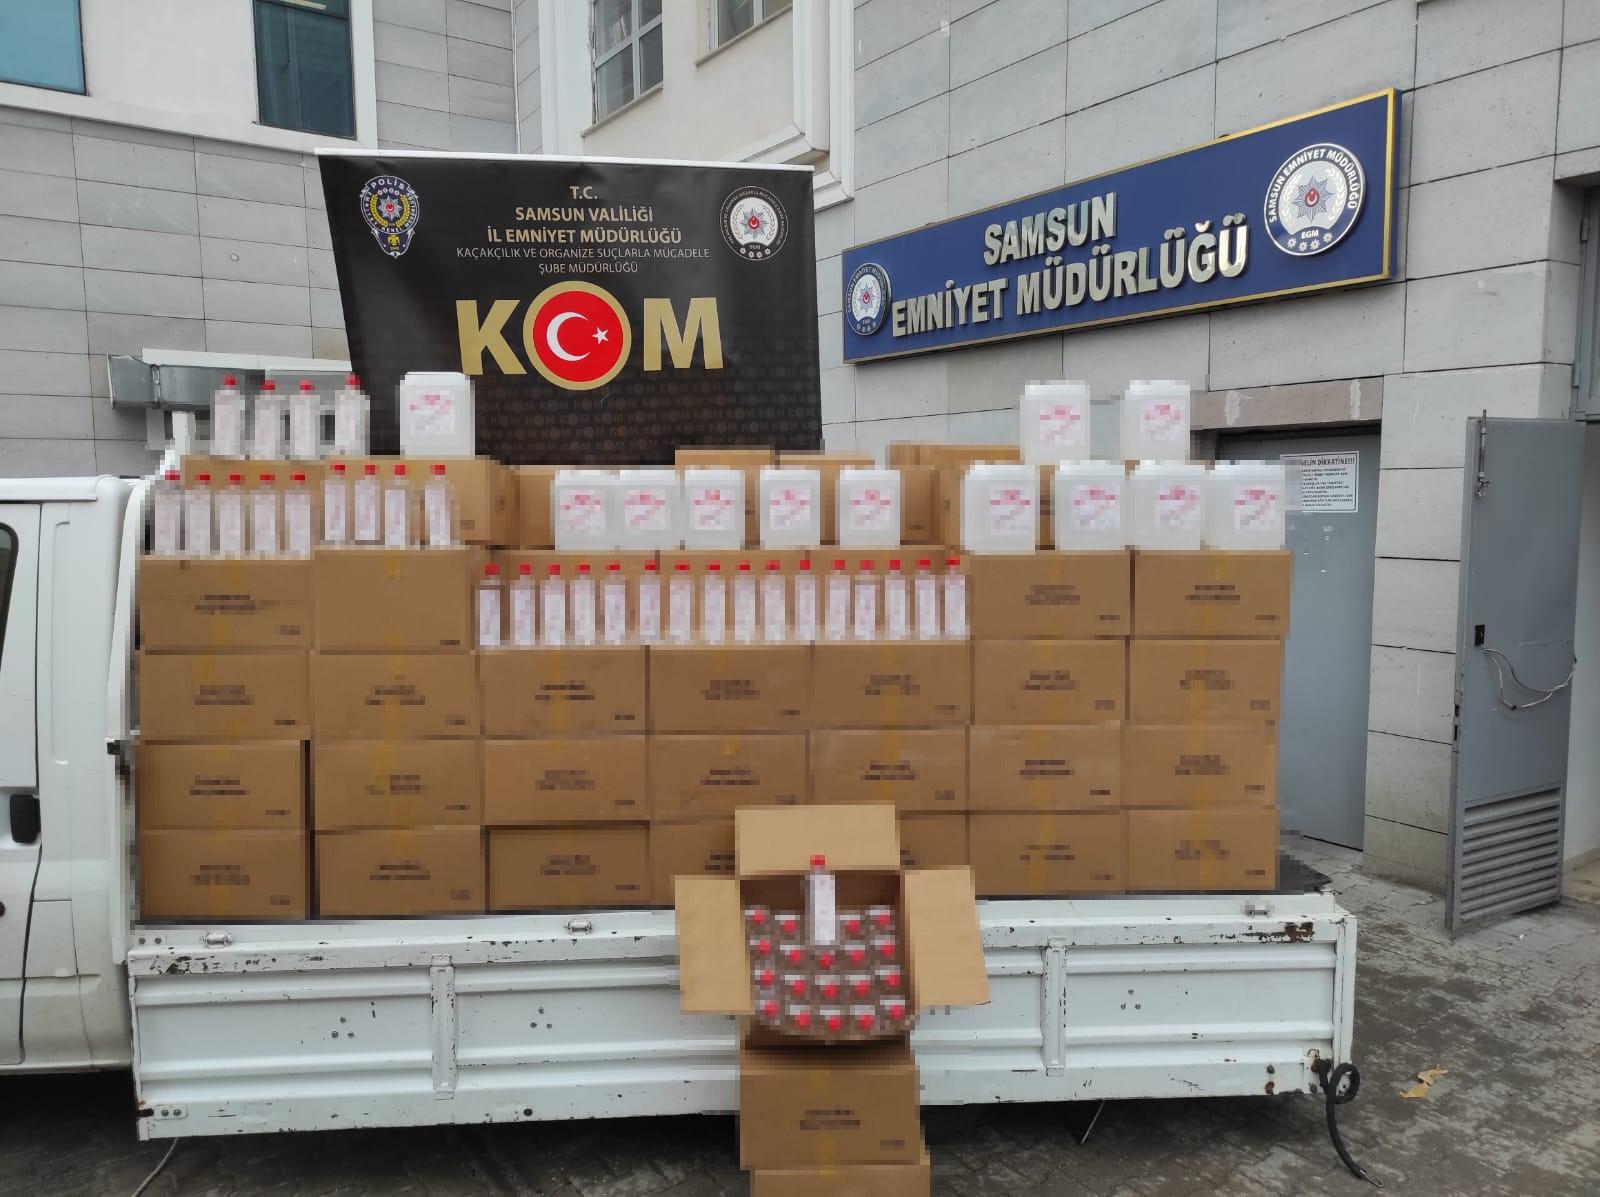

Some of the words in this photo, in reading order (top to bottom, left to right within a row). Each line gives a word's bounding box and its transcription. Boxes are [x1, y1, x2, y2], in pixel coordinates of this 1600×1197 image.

[370, 178, 405, 190] POLİS
[569, 185, 598, 200] T.C.
[1269, 175, 1286, 223] SAMSUN
[1283, 149, 1326, 177] EMNİYET
[1326, 149, 1360, 209] MÜDÜRLÜĞÜ
[515, 206, 585, 222] SAMSUN
[588, 204, 654, 223] VALİLİĞİ
[487, 225, 503, 243] İL
[505, 226, 576, 243] EMNİYET
[580, 226, 682, 244] MÜDÜRLÜĞÜ
[983, 192, 1116, 266] SAMSUN
[1301, 229, 1319, 239] EGM
[456, 247, 521, 261] KAÇAKÇILIK
[523, 248, 537, 258] VE
[539, 246, 595, 259] ORGANİZE
[597, 248, 651, 260] SUÇLARLA
[538, 263, 566, 276] ŞUBE
[568, 262, 638, 273] MÜDÜRLÜĞÜ
[892, 279, 1009, 338] EMNİYET
[1016, 212, 1248, 316] MÜDÜRLÜĞÜ
